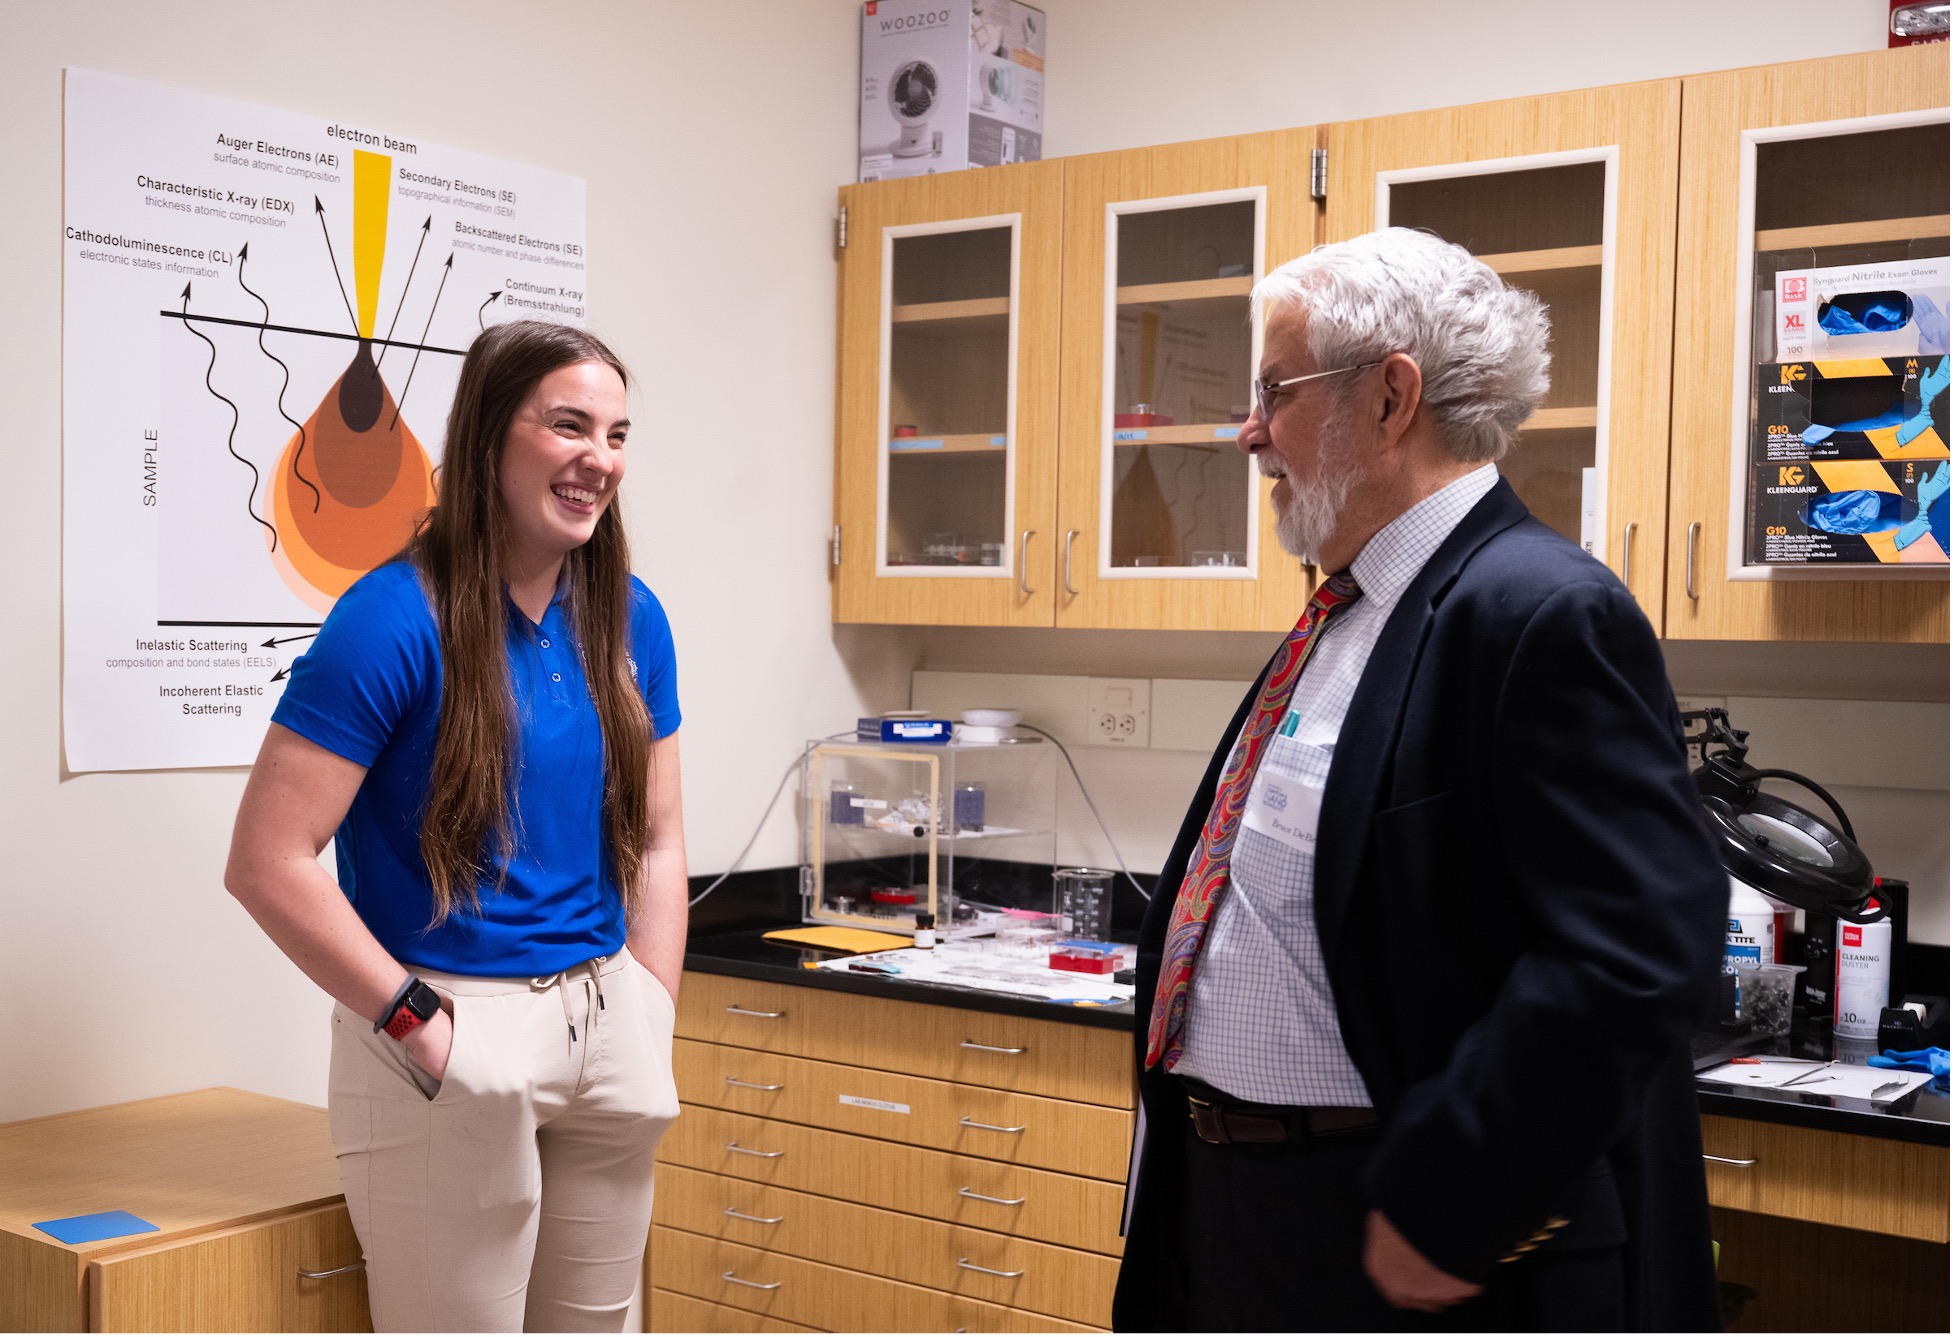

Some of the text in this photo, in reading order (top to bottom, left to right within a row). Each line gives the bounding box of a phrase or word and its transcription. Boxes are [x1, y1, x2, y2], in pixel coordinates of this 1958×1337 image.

[880, 10, 949, 31] WOOZOO
[327, 125, 417, 154] electron beam
[217, 133, 339, 169] Auger Electrons (AE)
[213, 152, 340, 183] surface atomic composition
[137, 175, 295, 215] Characteristic X-ray (EDX)
[399, 168, 517, 205] Secondary Electrons (SE)
[145, 195, 286, 228] thickness atomic composition
[398, 186, 516, 220] topographical information (SEM)
[66, 226, 233, 266] Cathodoluminescence (CL)
[455, 221, 583, 257] Backscattered Electrons (SE)
[80, 249, 219, 278] electronic states information
[452, 238, 584, 270] atomic number and phase differences
[1813, 274, 1850, 286] Synguard
[1852, 271, 1886, 281] Nitrile
[1911, 268, 1938, 276] Gloves
[506, 278, 584, 301] Continuum X-ray
[504, 294, 584, 317] (Bremsstrahlung)
[1785, 314, 1804, 328] XL
[1787, 345, 1803, 354] 100
[1906, 358, 1918, 368] M
[1767, 425, 1789, 435] G10
[143, 429, 158, 507] SAMPLE
[1906, 462, 1914, 472] S
[1767, 486, 1817, 494] KLEENGUARD
[1766, 526, 1787, 535] G10
[136, 639, 248, 653] Inelastic Scattering
[106, 657, 276, 669] composition and bond states (EELS)
[159, 685, 263, 697] Incoherent Elastic
[182, 703, 242, 716] Scattering
[1841, 960, 1869, 969] DUSTER
[1842, 953, 1880, 962] CLEANING
[1844, 1012, 1857, 1023] 10
